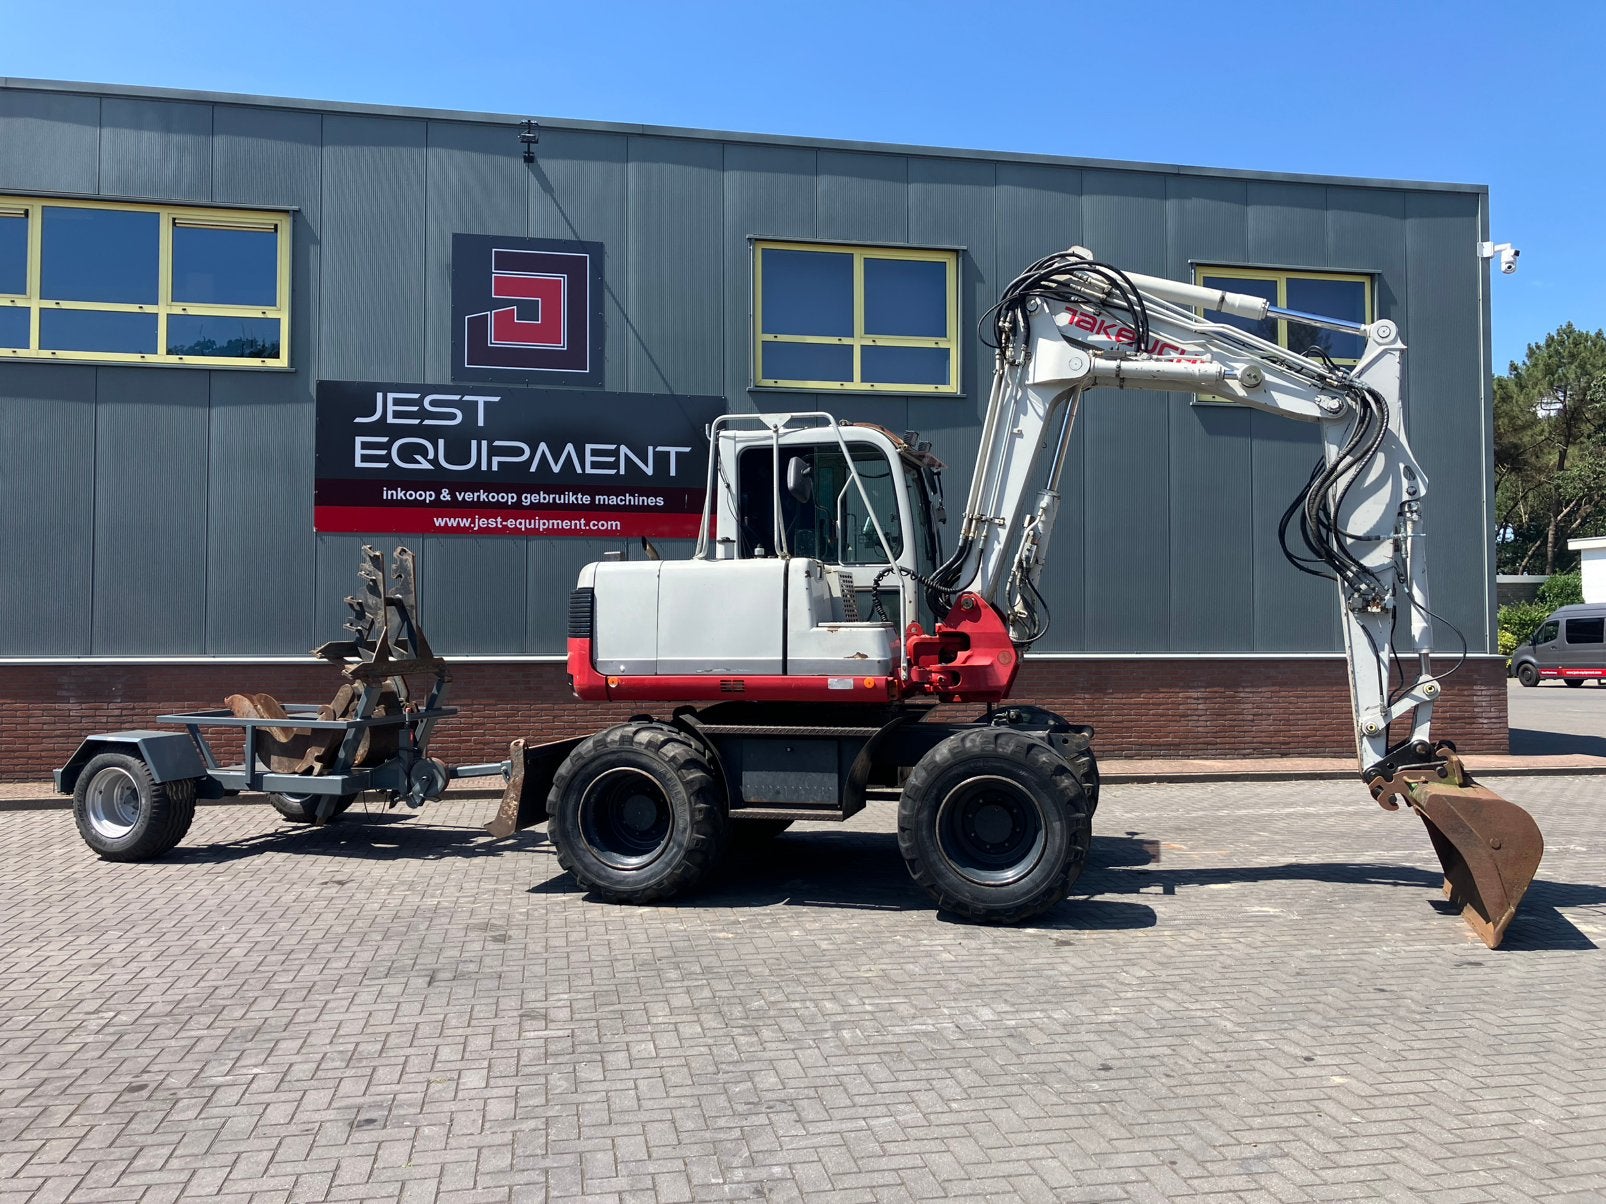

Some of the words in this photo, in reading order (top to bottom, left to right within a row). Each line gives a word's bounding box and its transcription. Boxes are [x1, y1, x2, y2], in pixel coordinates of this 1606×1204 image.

[353, 391, 502, 427] JEST
[354, 436, 692, 477] EQUIPMENT
[382, 487, 436, 504] inkoop
[440, 488, 452, 502] &
[455, 489, 518, 506] verkoop
[521, 490, 592, 508] gebruikte
[595, 493, 664, 507] machines
[433, 515, 621, 533] www.jest-equipment.com
